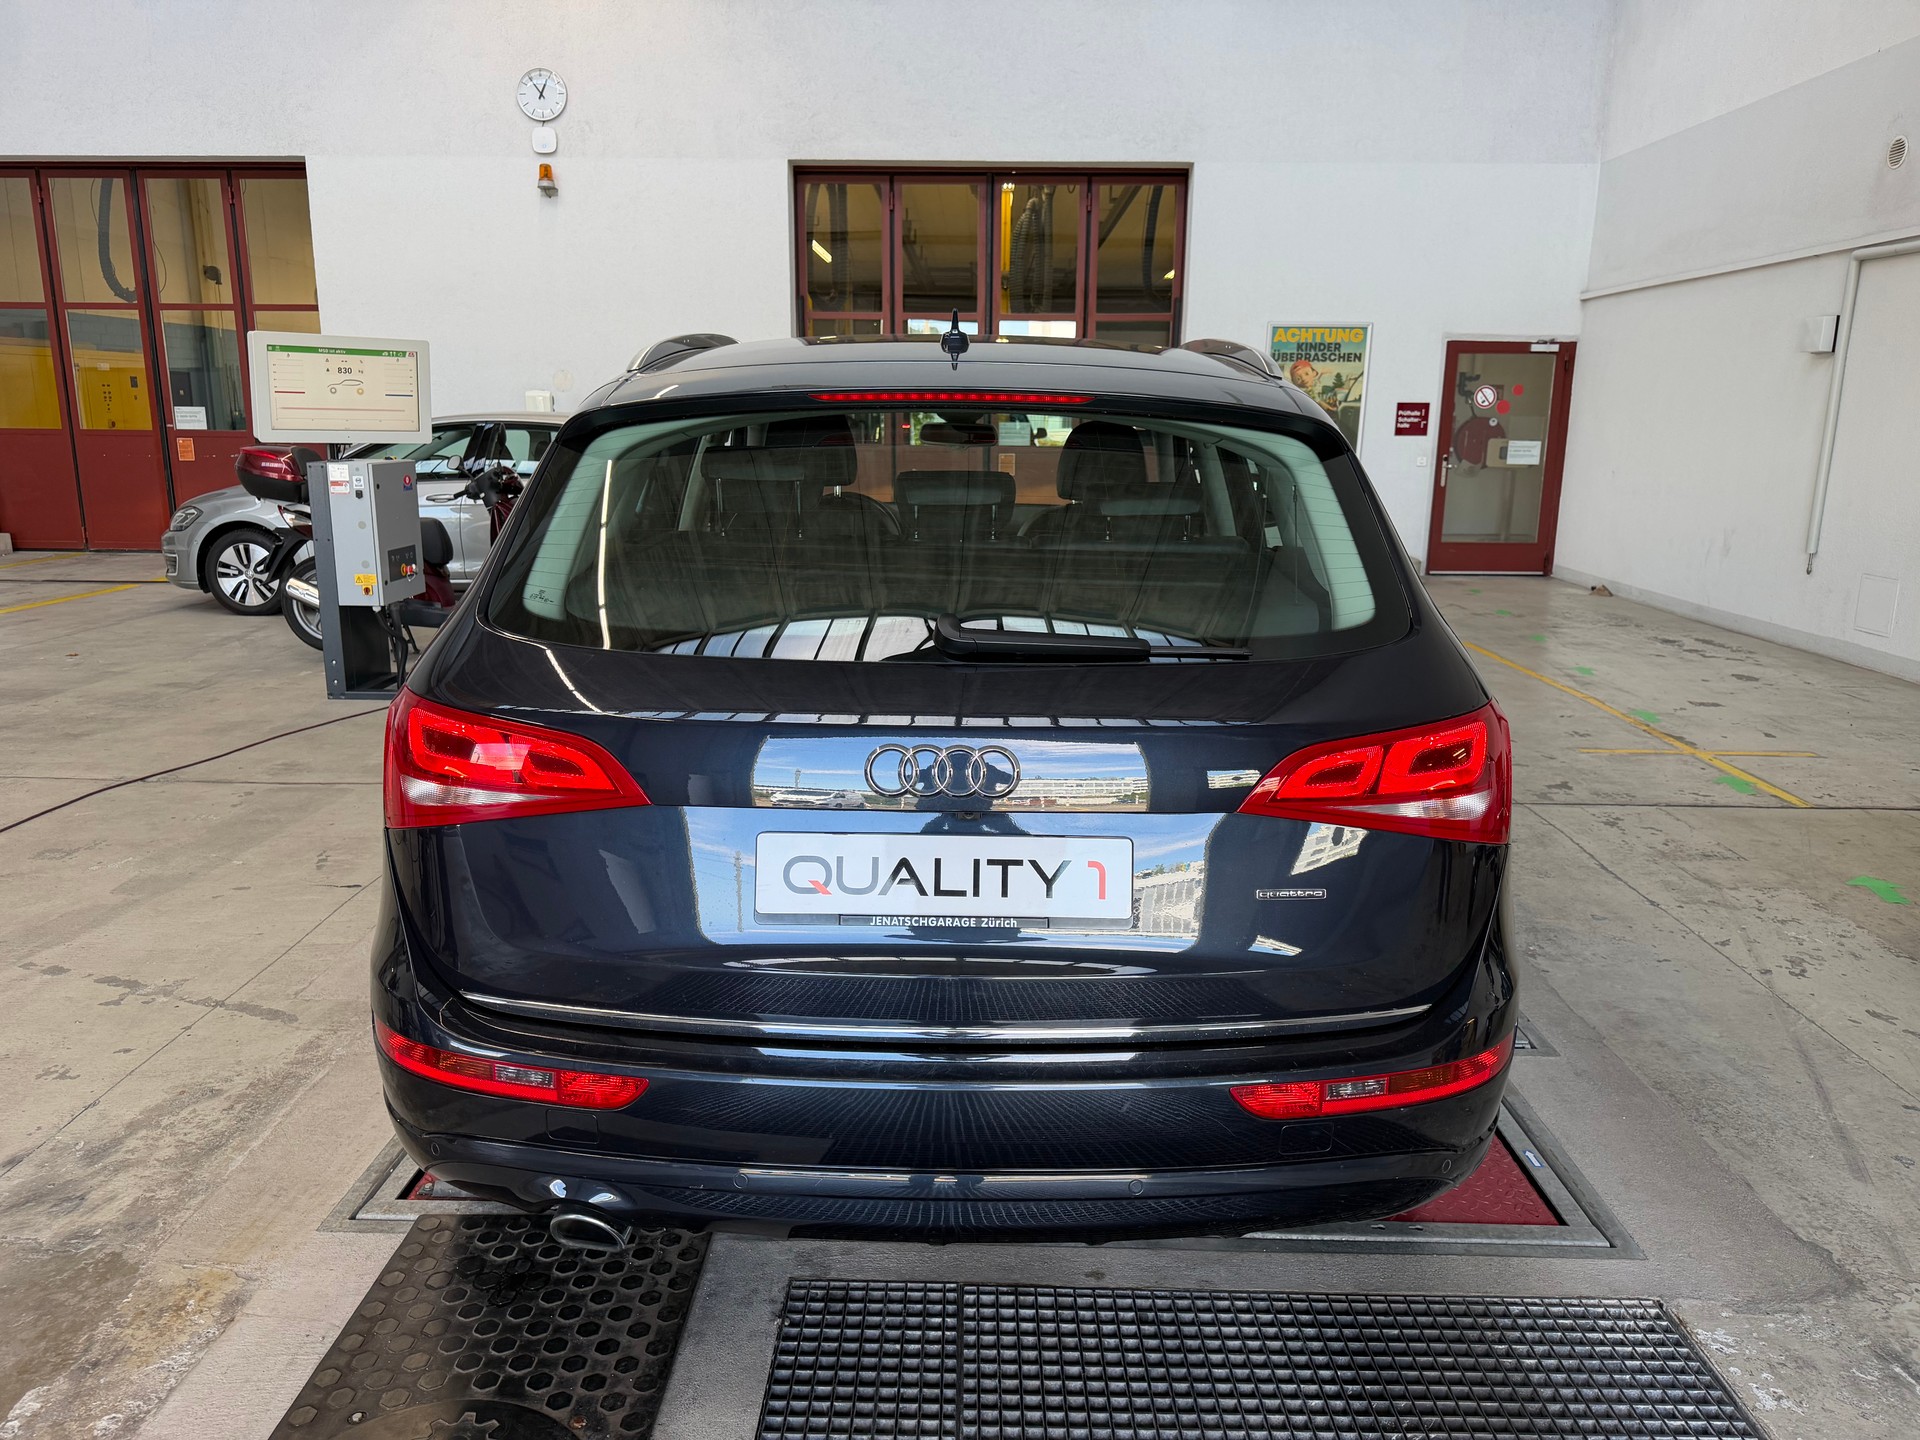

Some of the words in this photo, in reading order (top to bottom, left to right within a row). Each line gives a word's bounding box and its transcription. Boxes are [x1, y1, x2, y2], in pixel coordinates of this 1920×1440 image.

[1273, 328, 1364, 343] ACHTUNG
[1296, 342, 1342, 353] KINDER
[1272, 349, 1363, 363] ÜBERRASCHEN
[782, 855, 1073, 898] QUALITY
[1087, 860, 1107, 900] 1
[1259, 890, 1323, 898] quattro
[869, 915, 976, 927] JENATSCHGARAGE
[980, 917, 1018, 928] Zürich
